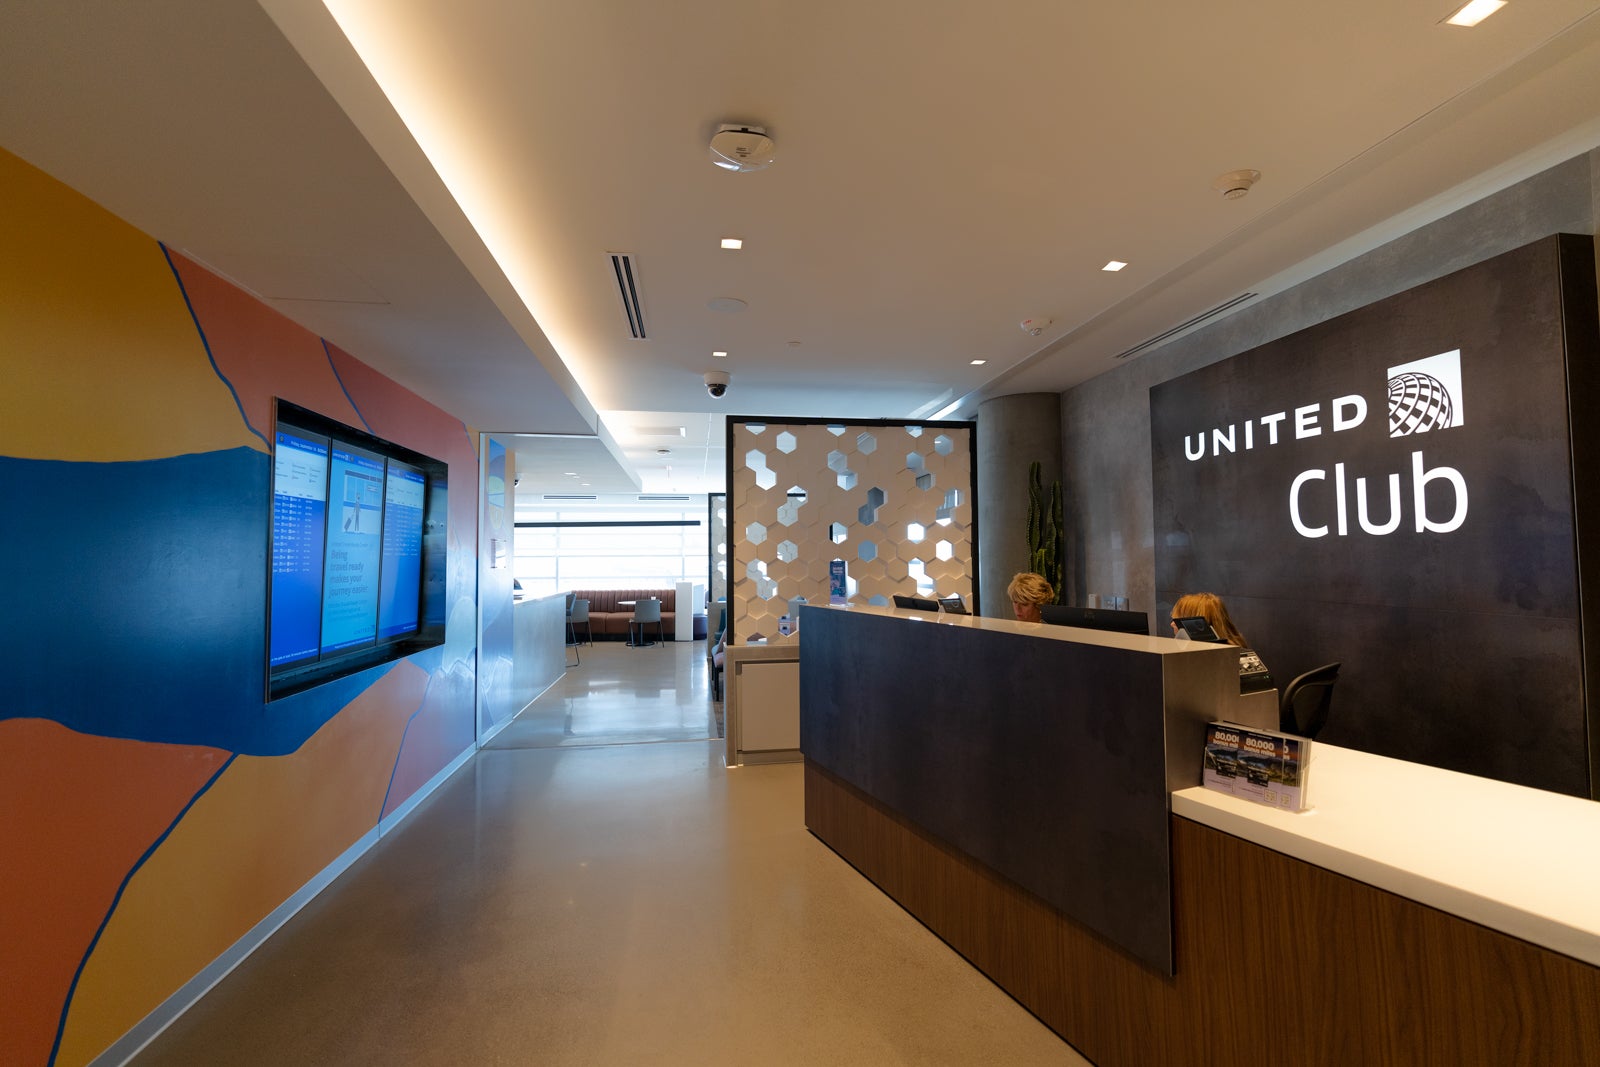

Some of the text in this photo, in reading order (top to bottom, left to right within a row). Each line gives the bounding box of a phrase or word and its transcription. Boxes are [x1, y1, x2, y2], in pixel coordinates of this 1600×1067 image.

[1184, 394, 1368, 462] UNITED
[1289, 450, 1468, 538] Club
[331, 549, 348, 561] Being
[330, 562, 364, 573] travel ready
[1215, 731, 1239, 743] 80,00
